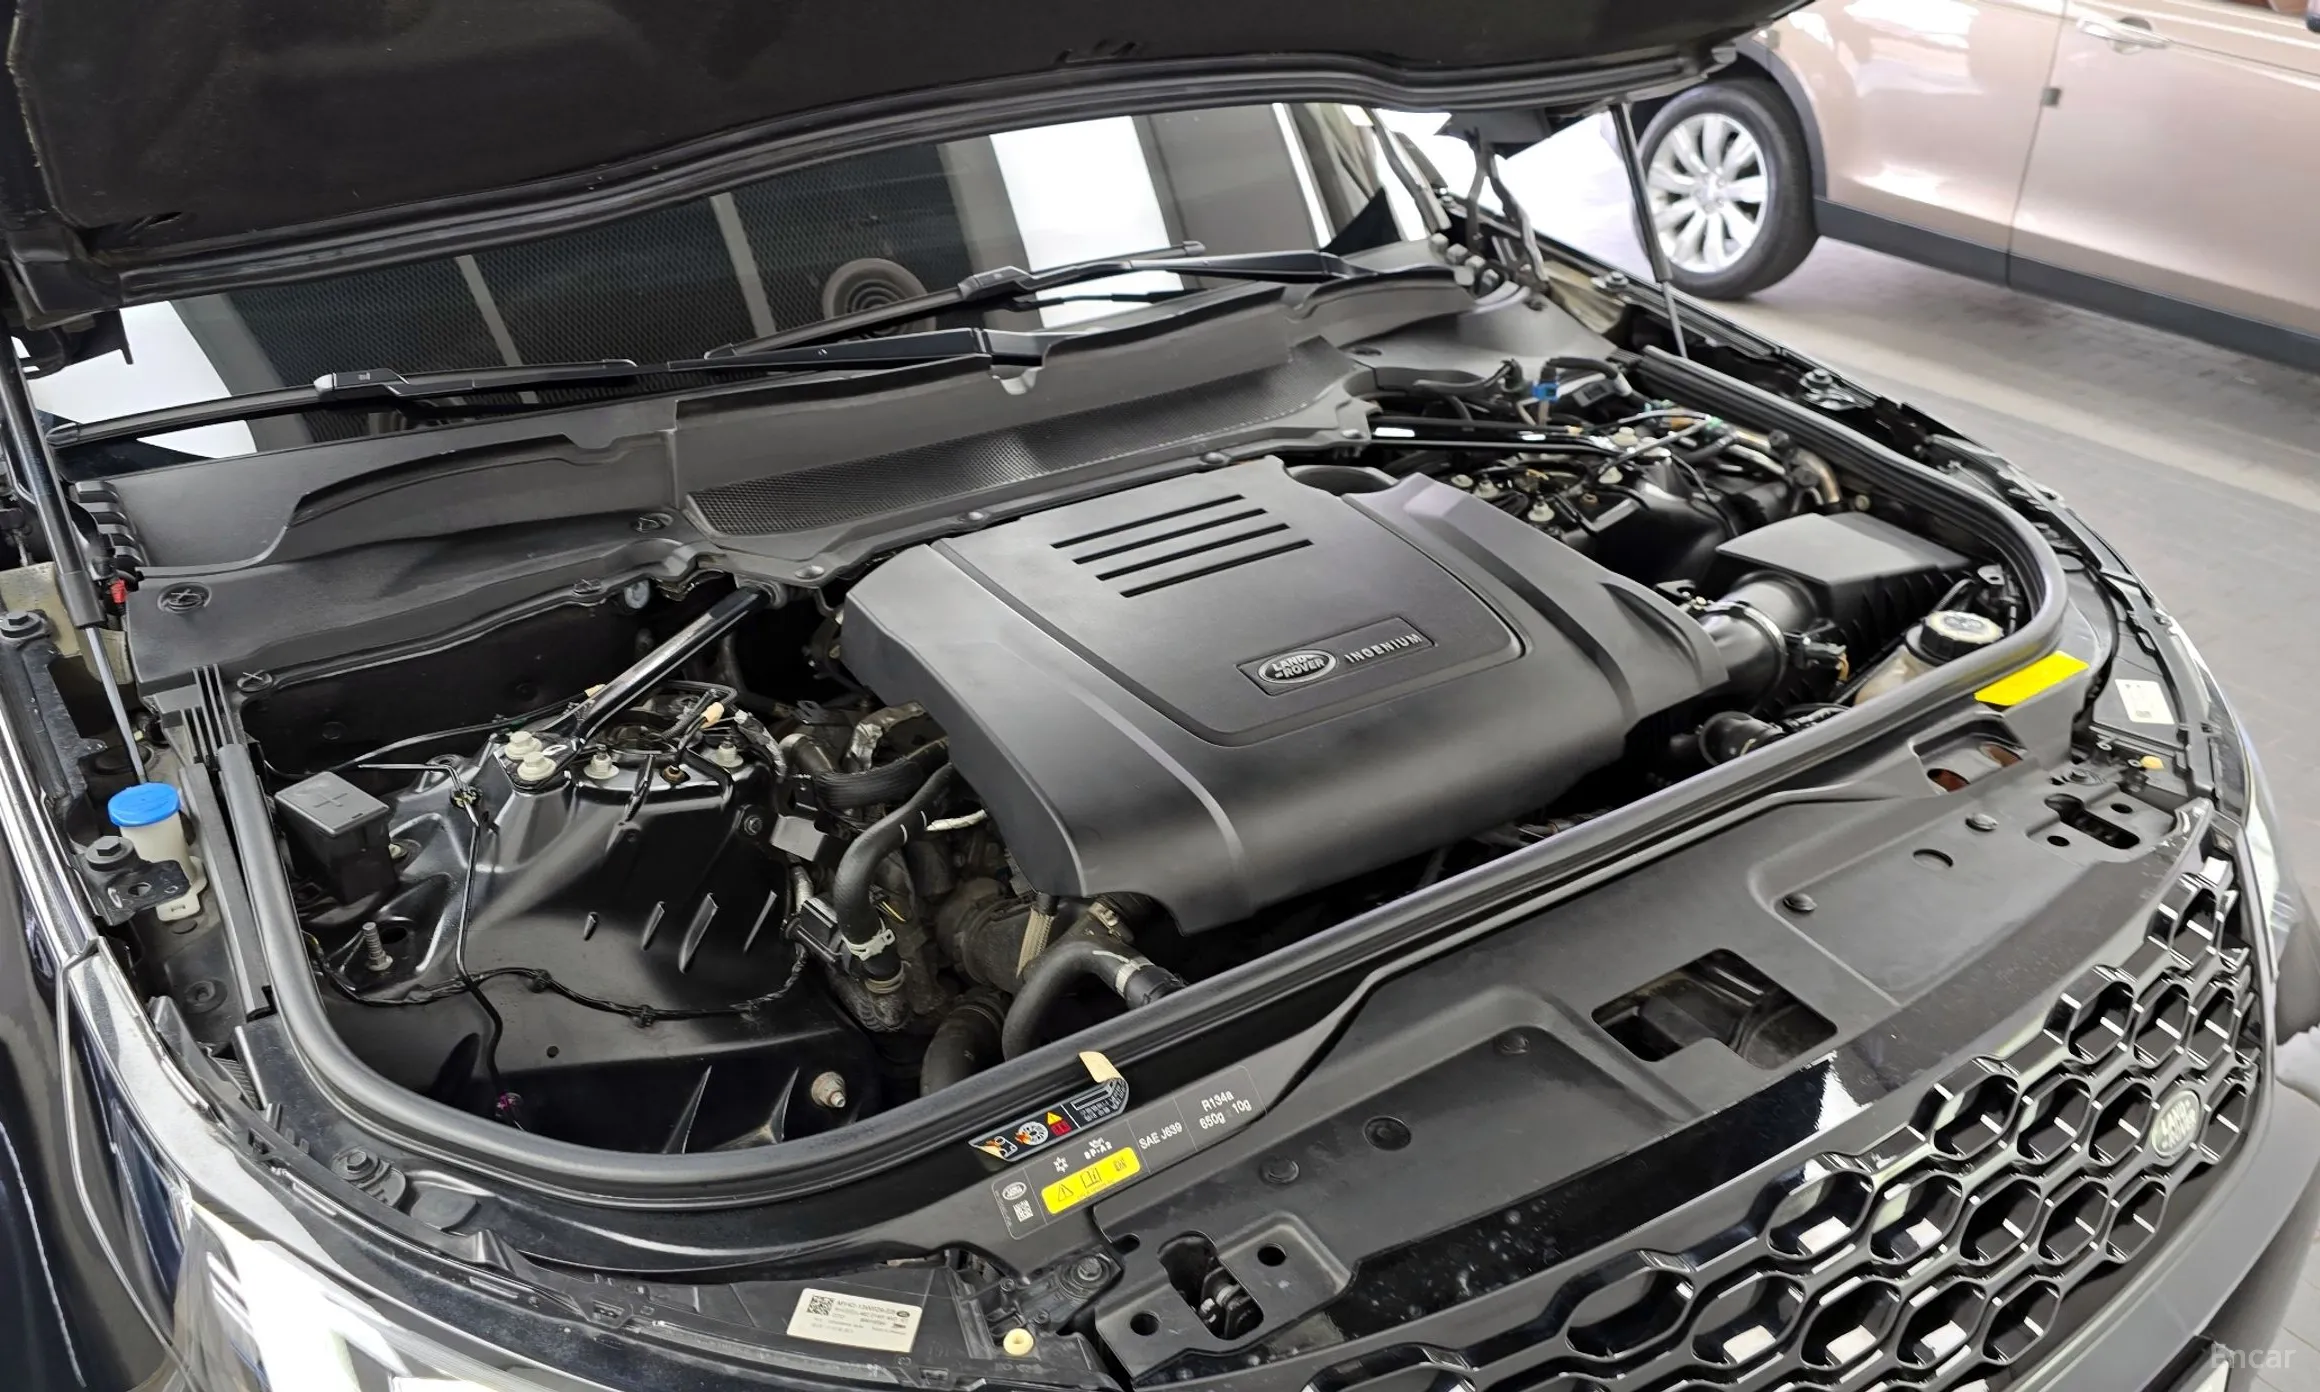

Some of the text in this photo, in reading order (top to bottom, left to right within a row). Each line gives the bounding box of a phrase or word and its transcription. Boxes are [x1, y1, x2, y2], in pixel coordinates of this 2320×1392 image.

[1344, 633, 1423, 664] INGENIUM
[1272, 654, 1307, 672] LAND
[1283, 657, 1325, 679] ROVER
[1201, 1090, 1234, 1112] R134a
[1199, 1099, 1252, 1130] 650g 10g
[1138, 1122, 1182, 1149] SAE J639
